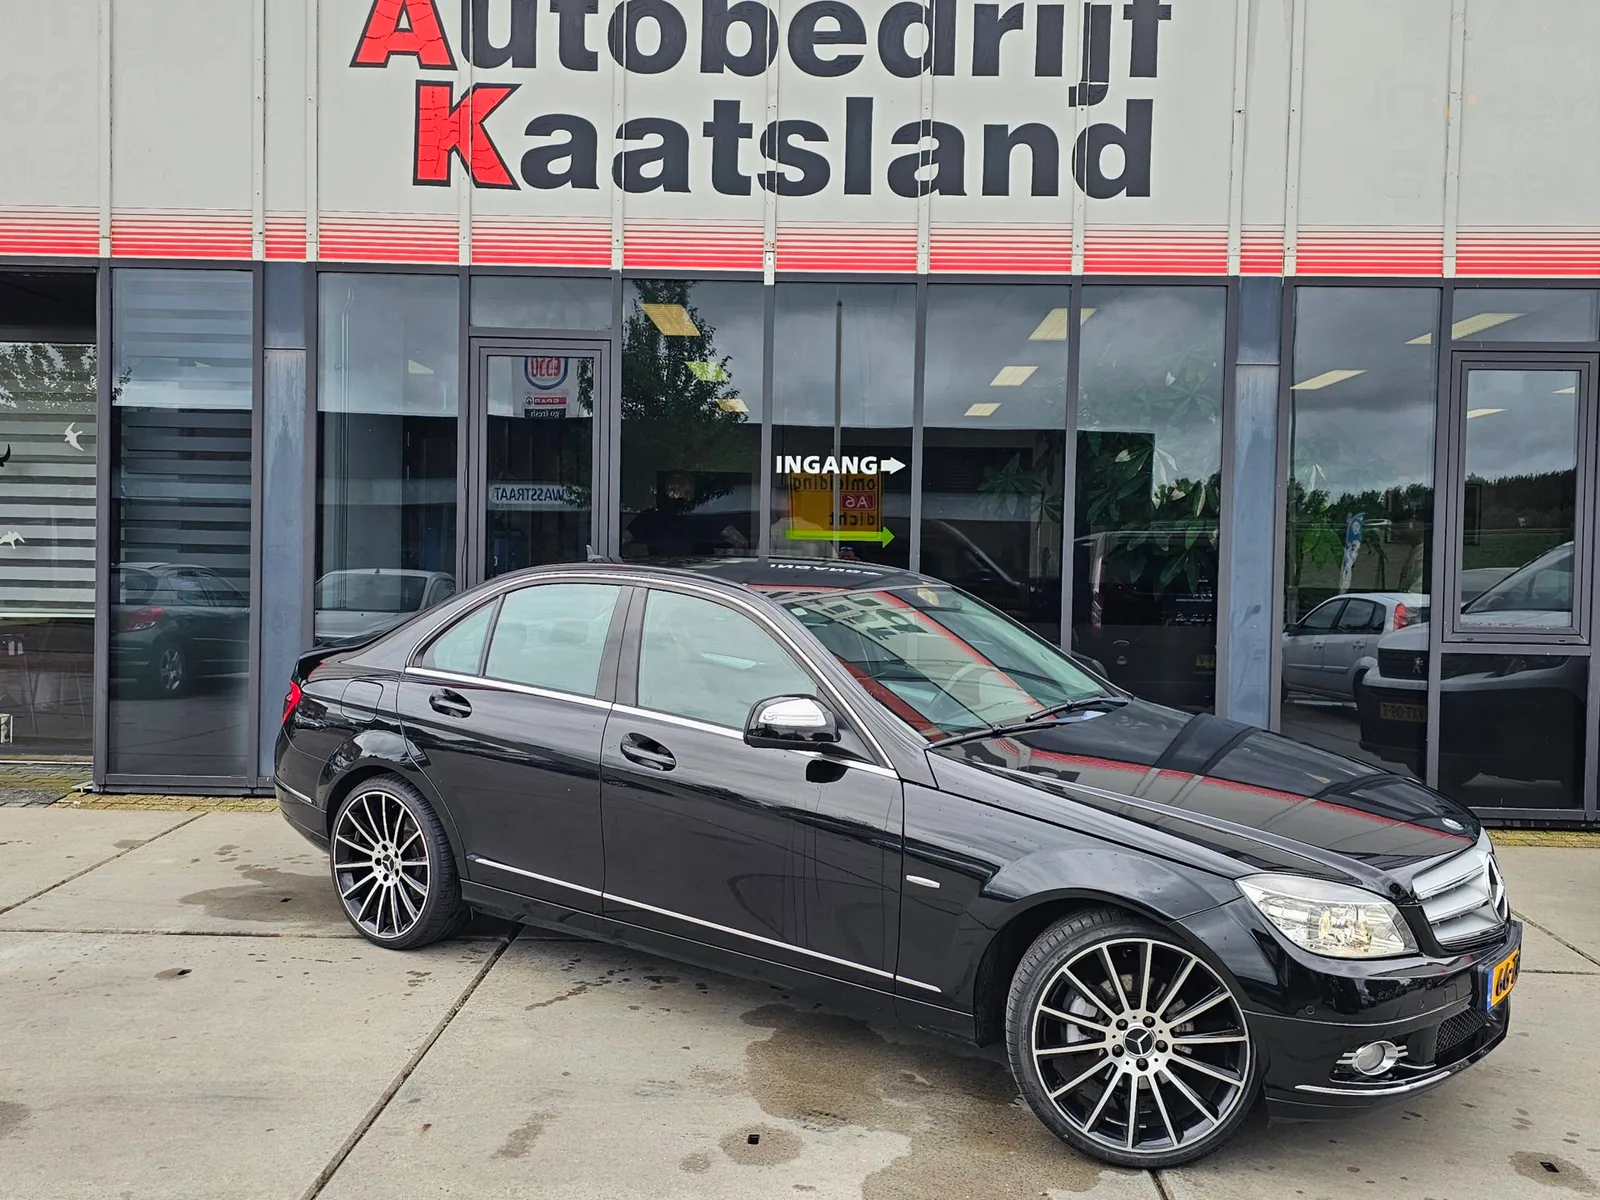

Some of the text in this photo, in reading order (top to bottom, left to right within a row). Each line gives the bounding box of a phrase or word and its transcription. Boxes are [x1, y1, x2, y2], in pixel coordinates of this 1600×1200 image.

[349, 0, 1172, 108] Autobedrijf
[413, 80, 1154, 199] Kaatsland
[776, 455, 878, 475] INGANG
